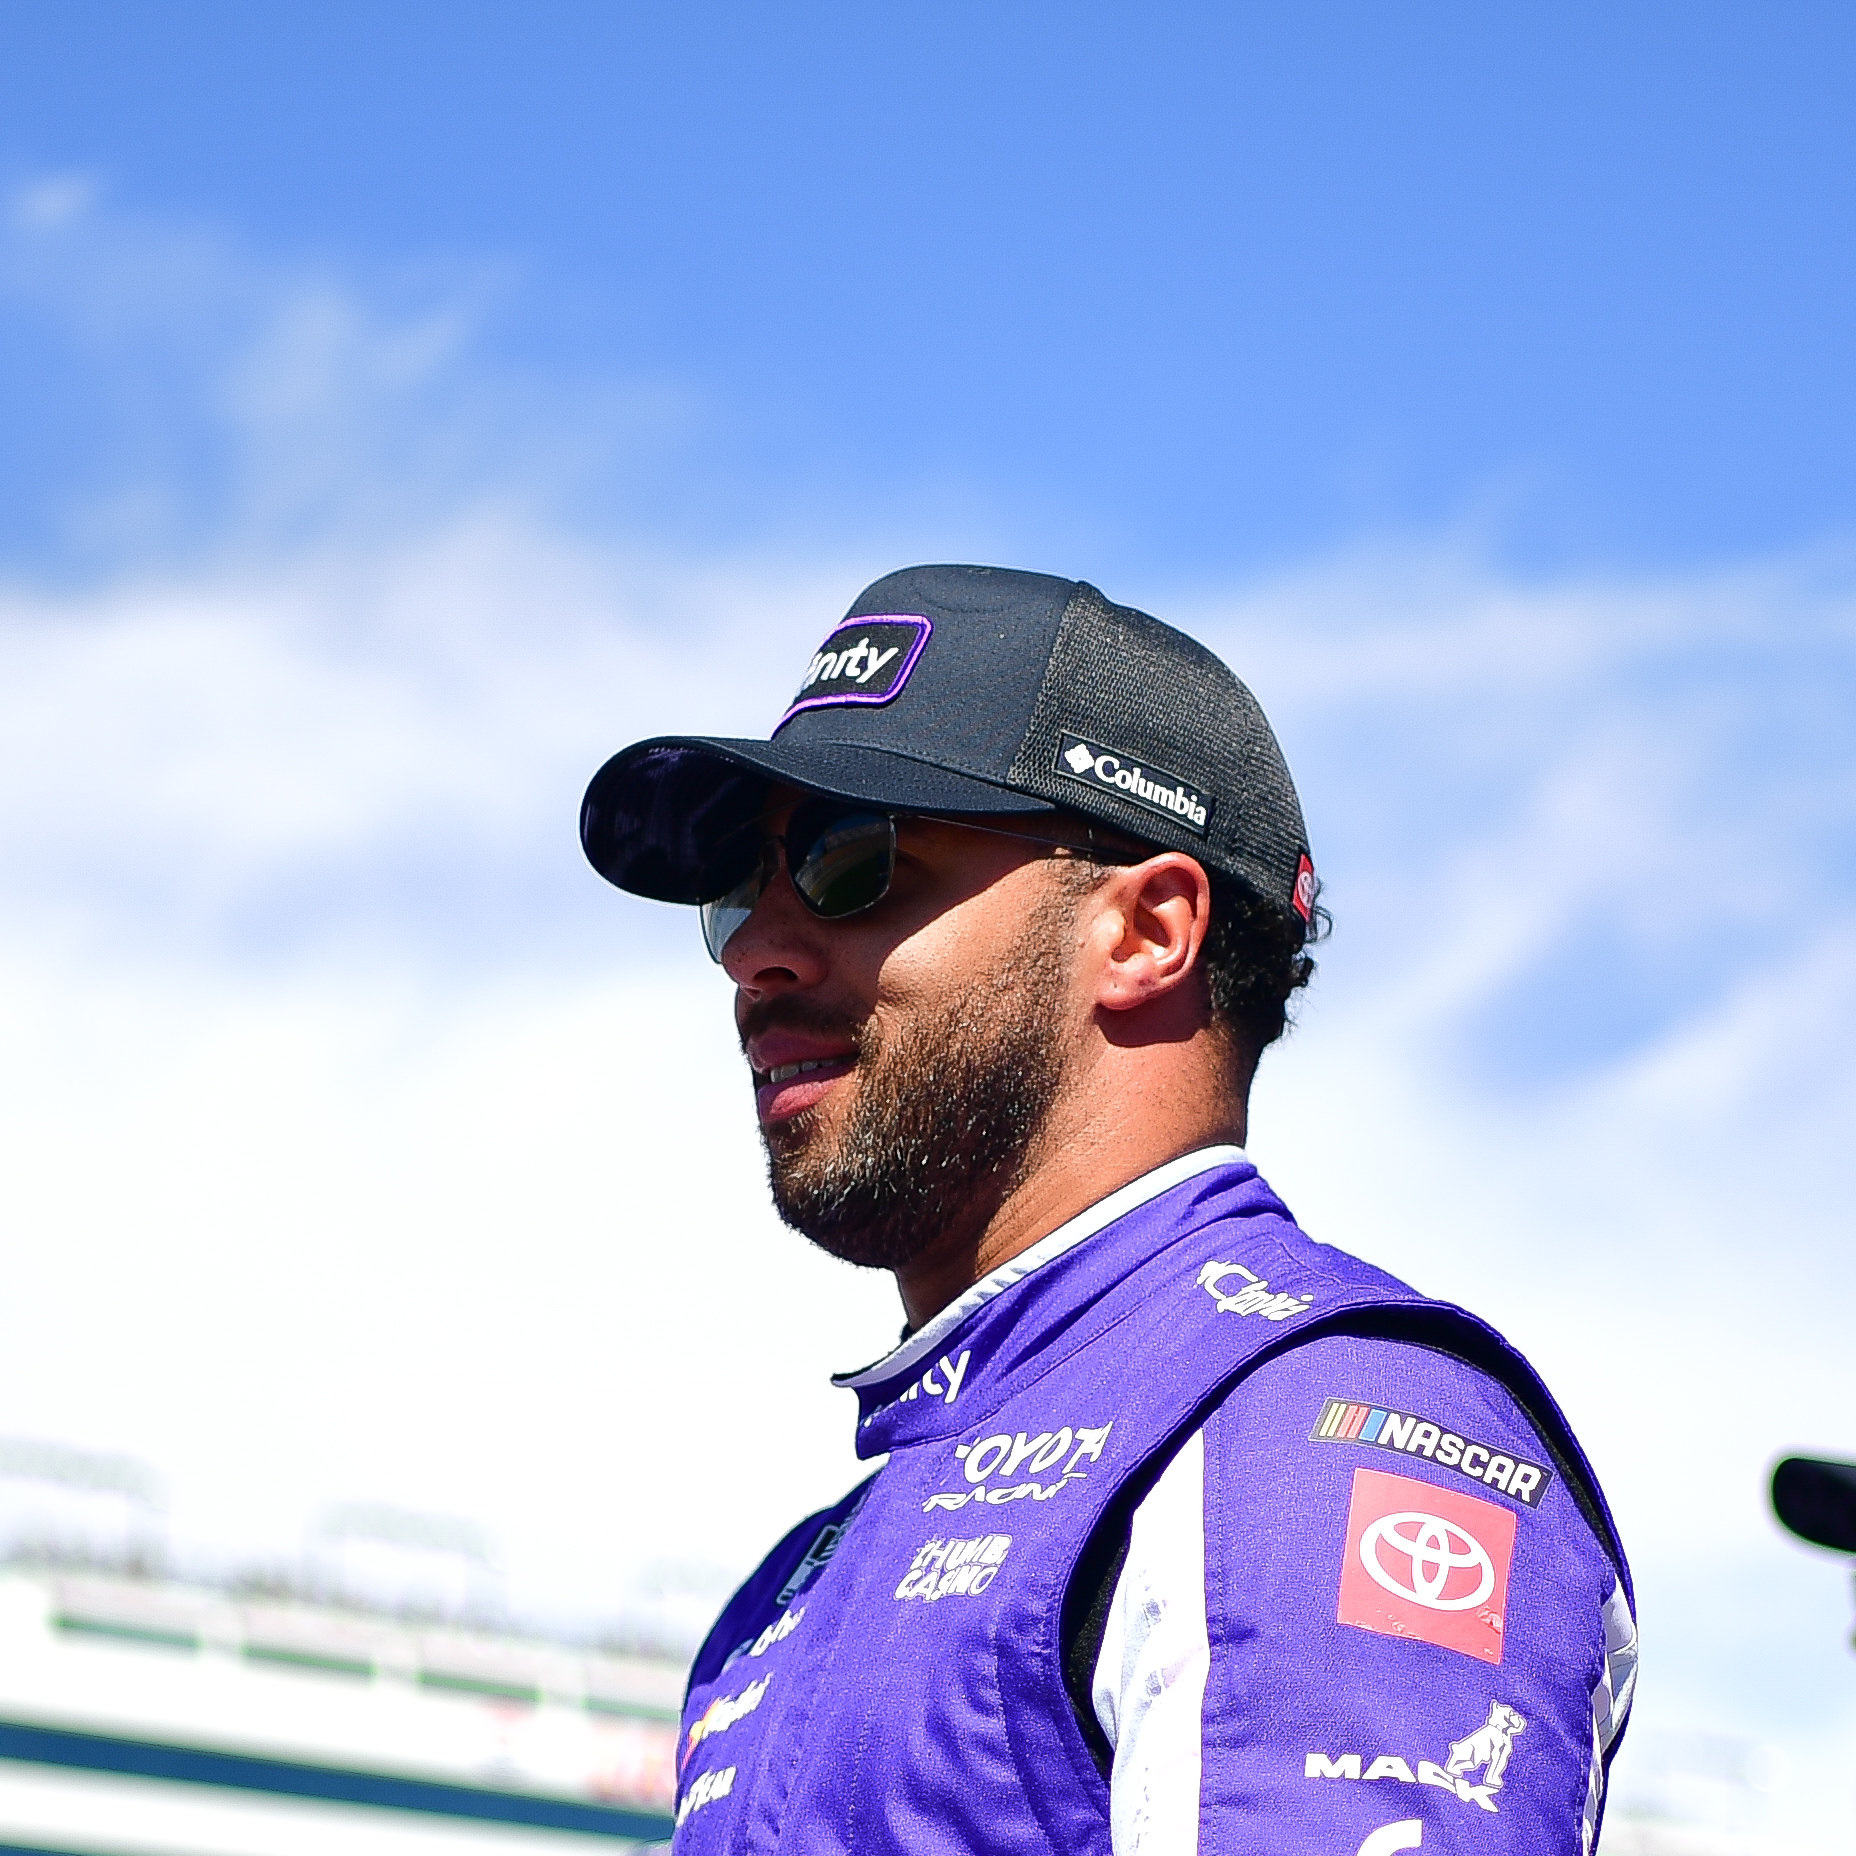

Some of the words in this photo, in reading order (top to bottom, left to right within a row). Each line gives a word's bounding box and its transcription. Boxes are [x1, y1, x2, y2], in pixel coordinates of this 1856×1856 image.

[1093, 753, 1210, 829] Columbia
[1376, 1412, 1543, 1503] NASCAR
[1303, 1752, 1502, 1813] MACK
